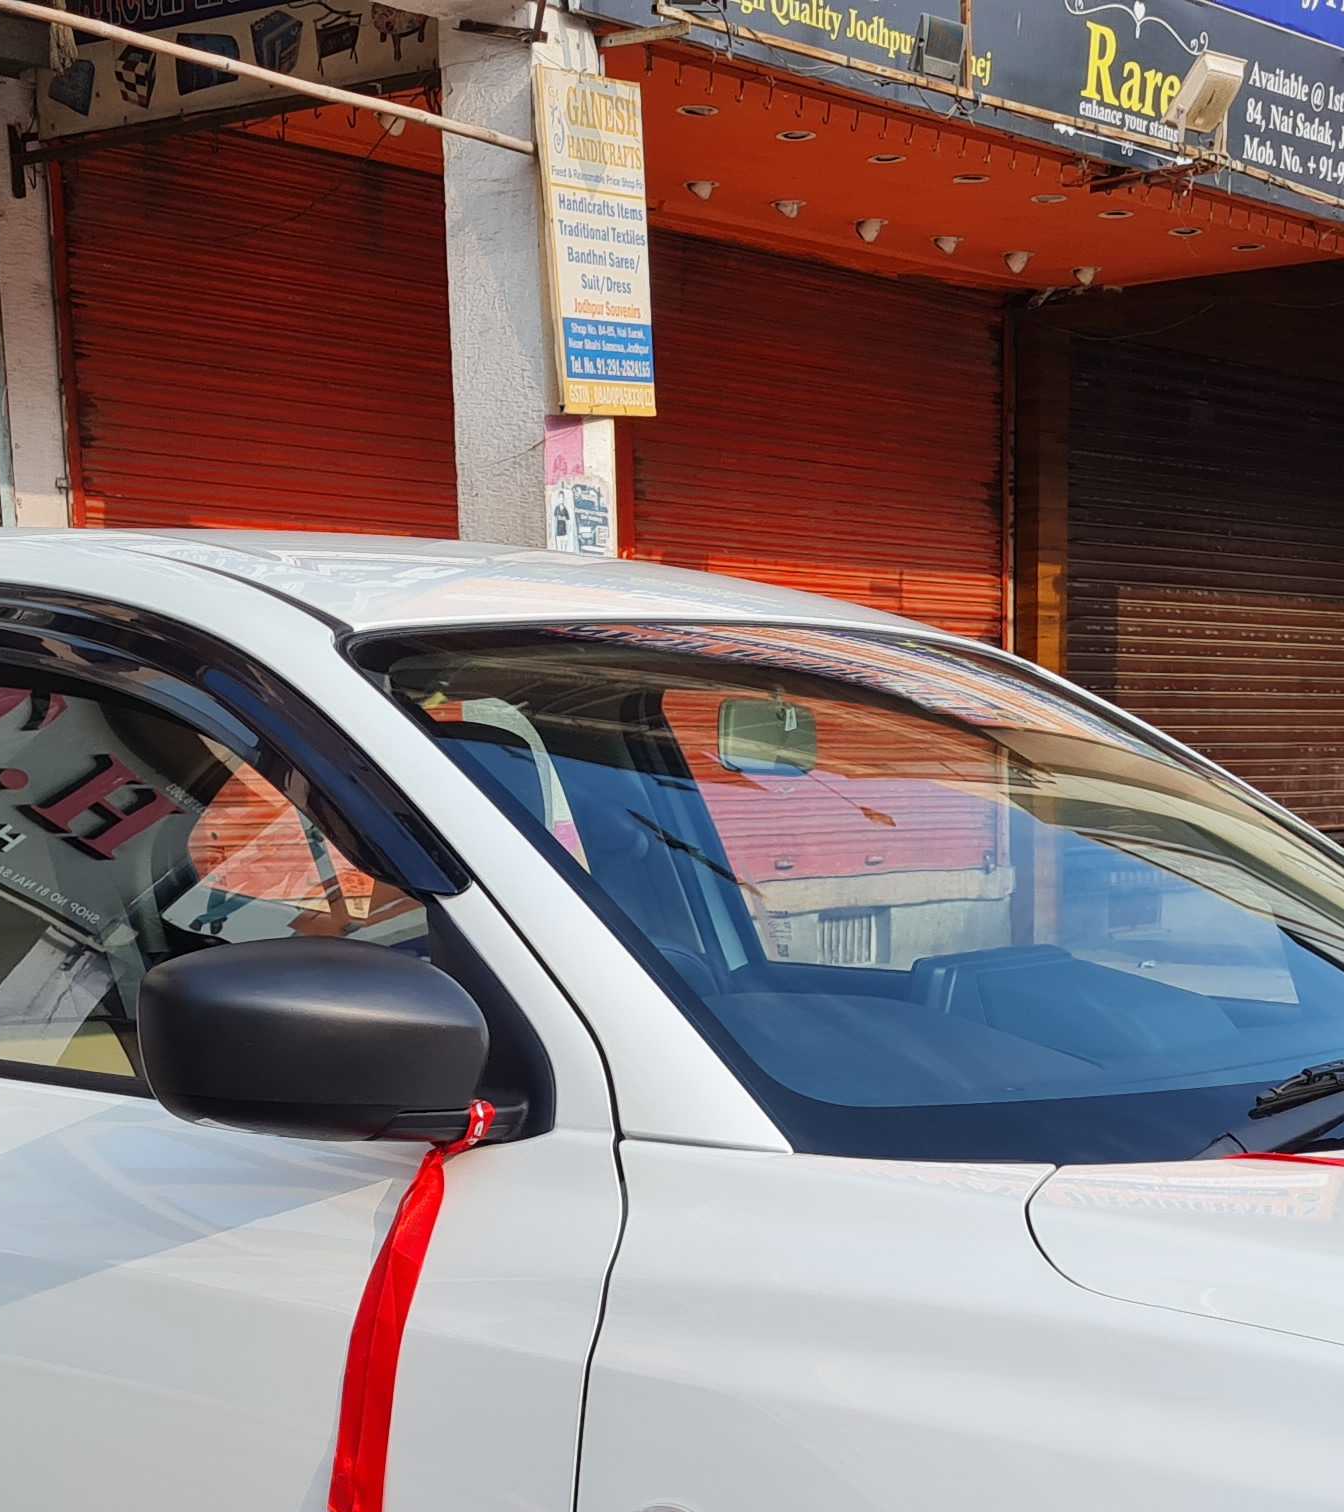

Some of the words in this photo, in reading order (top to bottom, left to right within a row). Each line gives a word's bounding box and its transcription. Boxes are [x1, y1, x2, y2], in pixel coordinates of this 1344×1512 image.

[770, 0, 843, 41] Quality
[846, 8, 915, 57] Jodhpu
[1080, 19, 1183, 118] Rare
[1248, 61, 1309, 102] Available
[1310, 82, 1326, 112] @
[566, 86, 639, 137] GANESH
[1079, 101, 1123, 126] enhance
[1124, 112, 1148, 134] your
[1149, 121, 1179, 143] status
[1245, 98, 1266, 132] 84,
[1269, 104, 1294, 135] Nai
[1295, 112, 1336, 152] Sadak,
[567, 135, 642, 170] HANDICRAFTS
[1242, 134, 1277, 168] Mob.
[1279, 144, 1304, 175] No.
[558, 192, 615, 217] Handicrafts
[617, 202, 643, 221] Items
[558, 218, 609, 242] Traditional
[612, 227, 646, 247] Textiles
[567, 246, 607, 266] Bandhni
[581, 273, 632, 295] Suit/Dress
[574, 297, 605, 318] Jodhpur
[570, 355, 584, 373] Tel.
